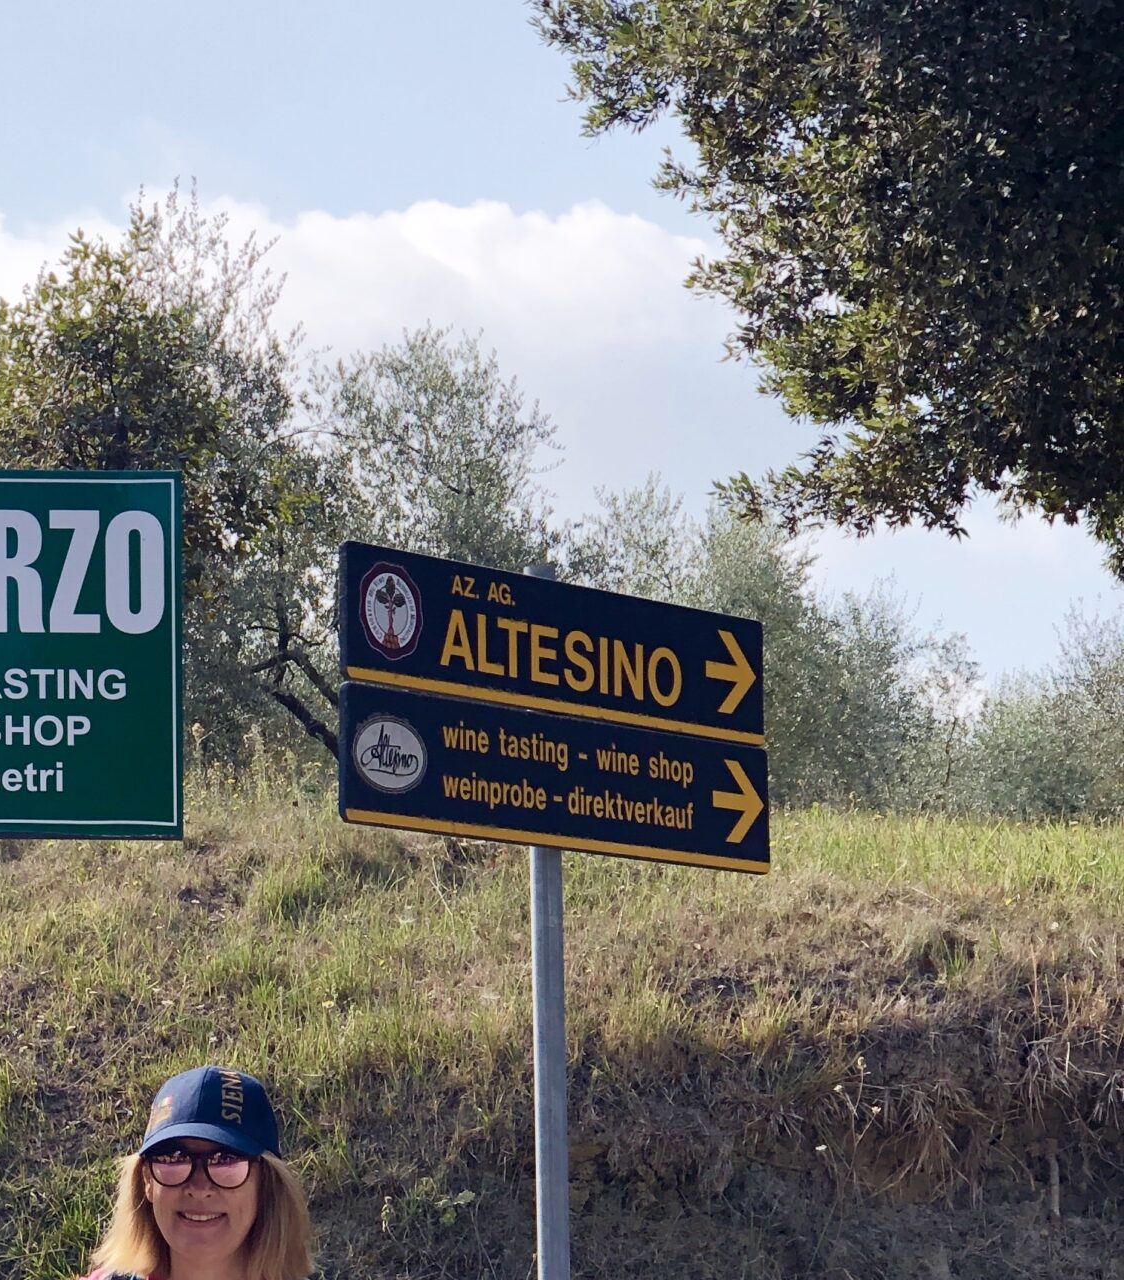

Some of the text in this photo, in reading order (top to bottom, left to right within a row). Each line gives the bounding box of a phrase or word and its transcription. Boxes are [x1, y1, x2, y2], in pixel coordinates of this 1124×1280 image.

[451, 574, 516, 606] AZ. AG.
[439, 608, 683, 708] ALTESINO
[442, 720, 489, 754] wine
[499, 727, 569, 771] tasting
[596, 744, 640, 776] wine
[649, 755, 694, 789] shop
[442, 771, 547, 810] weinprobe
[568, 784, 694, 831] direktverkauf
